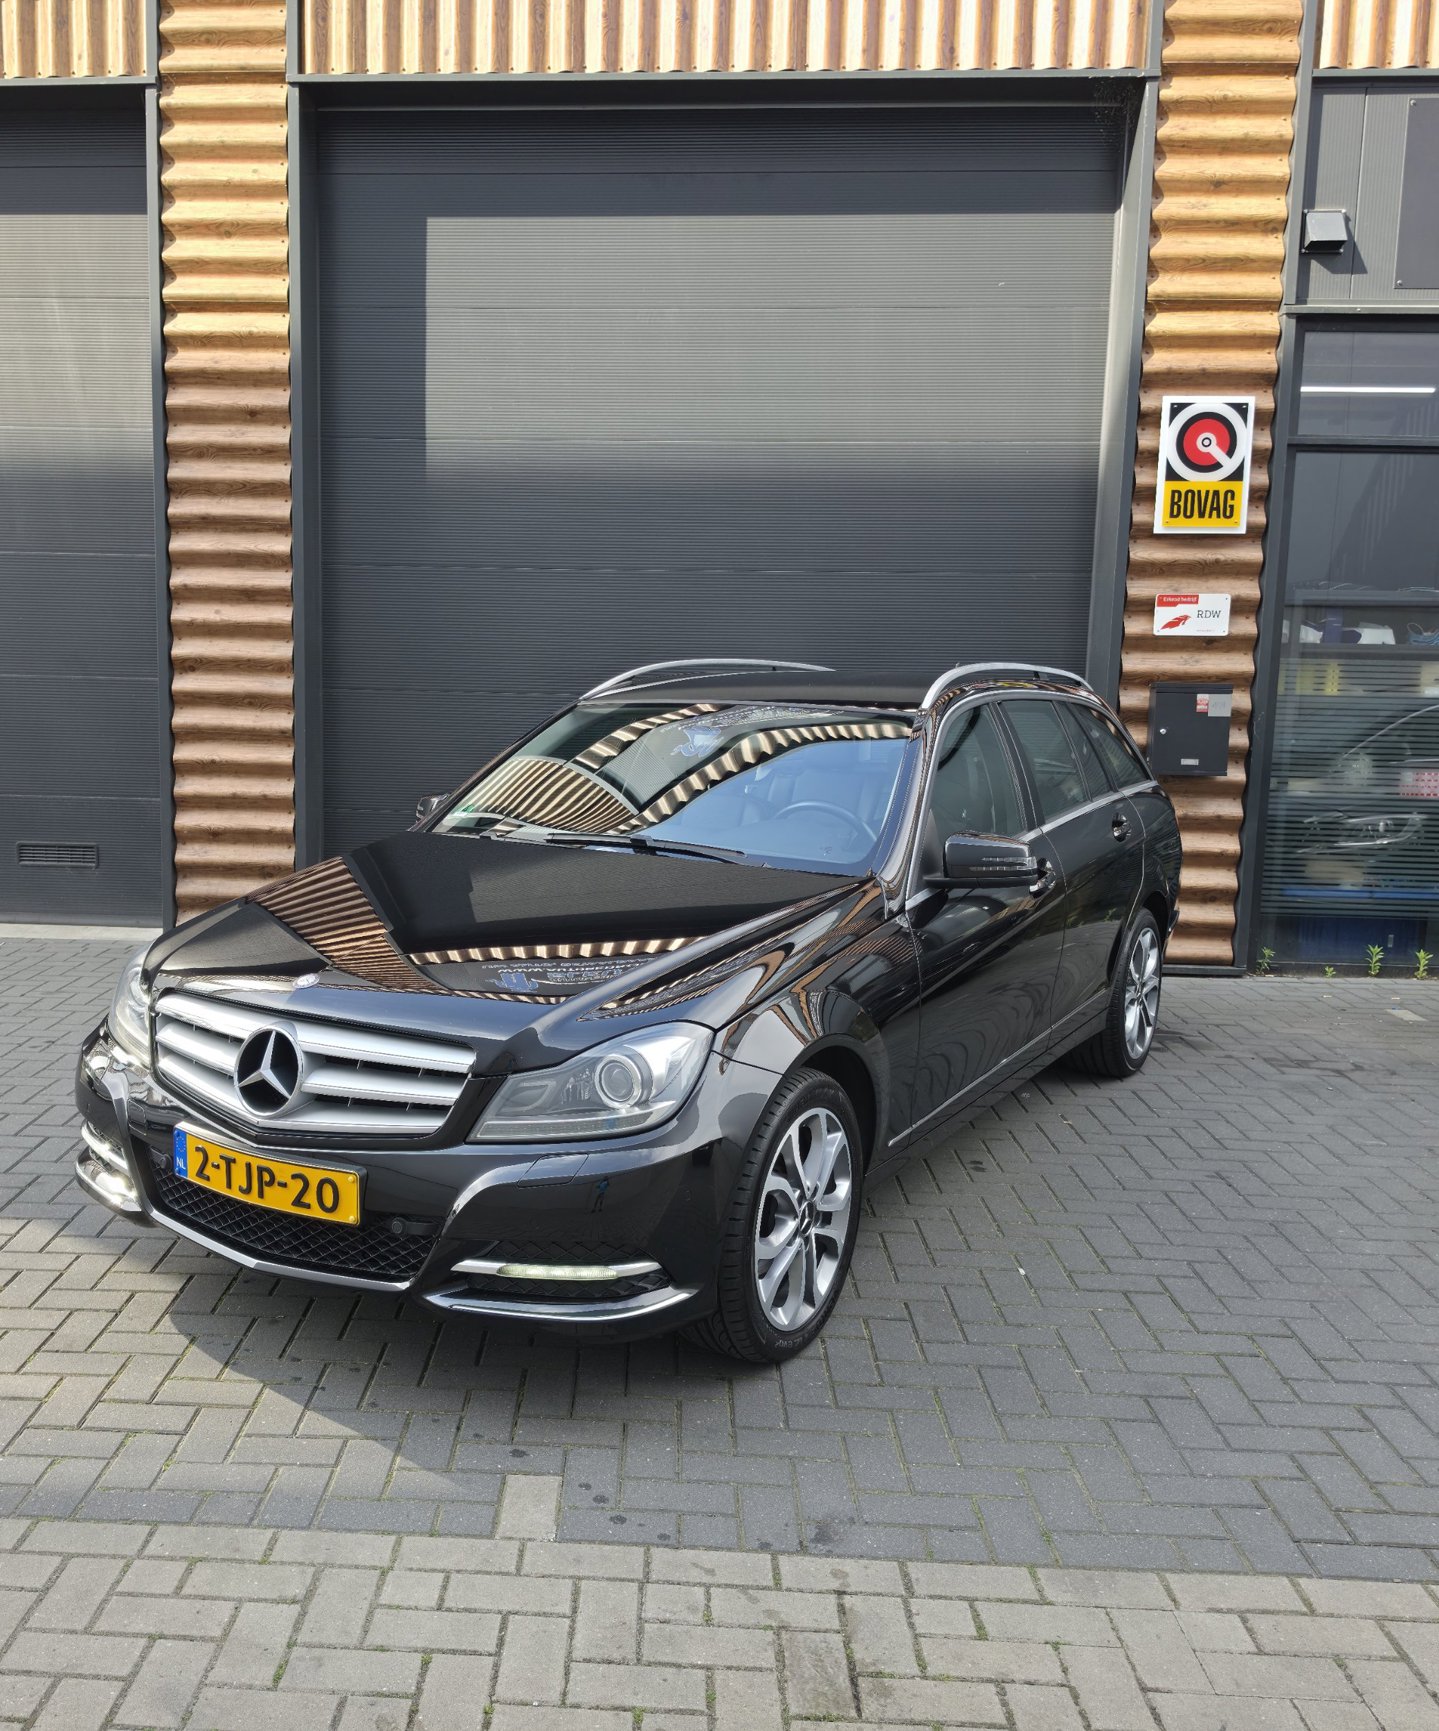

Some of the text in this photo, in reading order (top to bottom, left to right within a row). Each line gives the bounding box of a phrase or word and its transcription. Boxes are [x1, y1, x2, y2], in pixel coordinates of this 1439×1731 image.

[1169, 489, 1236, 519] BOVAG
[1197, 609, 1221, 618] RDW
[176, 1156, 186, 1170] NL
[195, 1145, 340, 1213] 2-TJP-20
